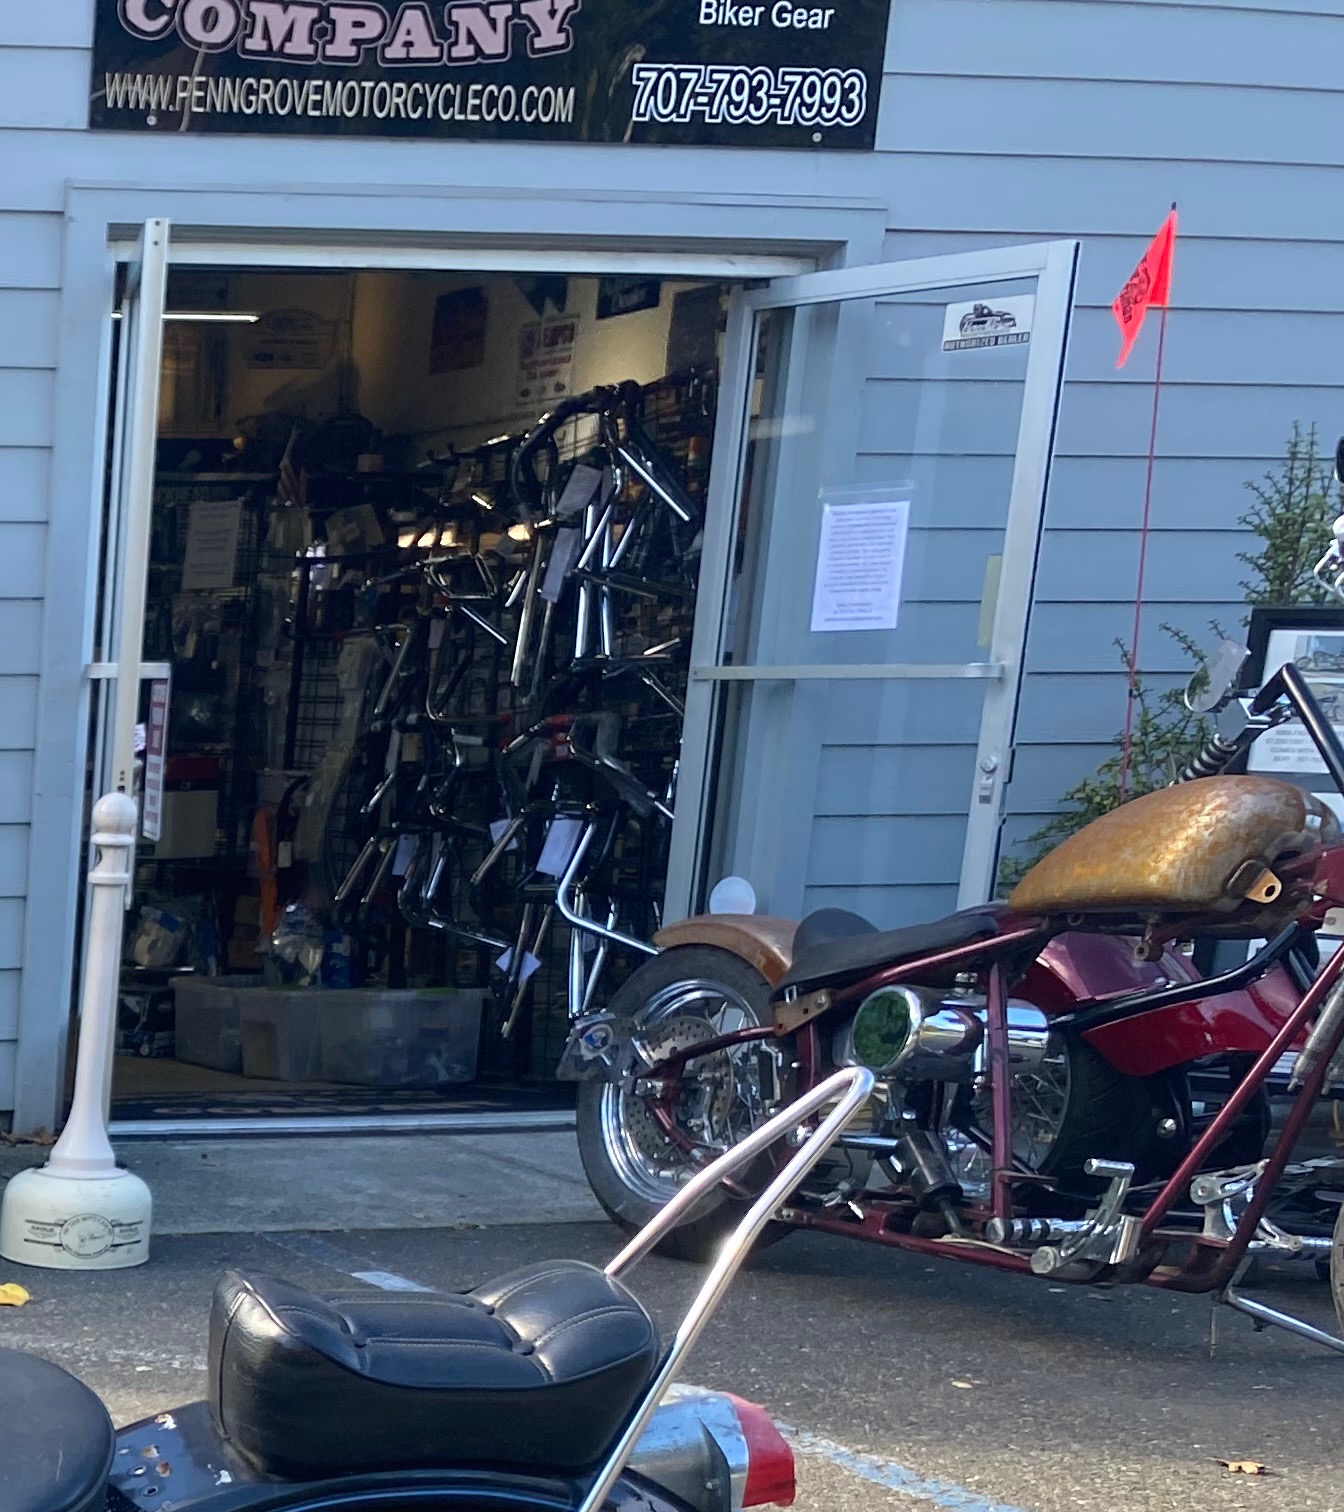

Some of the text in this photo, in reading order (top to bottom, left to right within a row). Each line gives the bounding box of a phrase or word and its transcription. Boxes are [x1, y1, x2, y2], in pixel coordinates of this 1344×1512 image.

[118, 0, 581, 66] COMPANY
[698, 0, 833, 30] Biker Gear
[105, 72, 576, 123] WWW.PENNGROVEMOTORCYCLECO.COM
[633, 63, 867, 126] 707-793-7993
